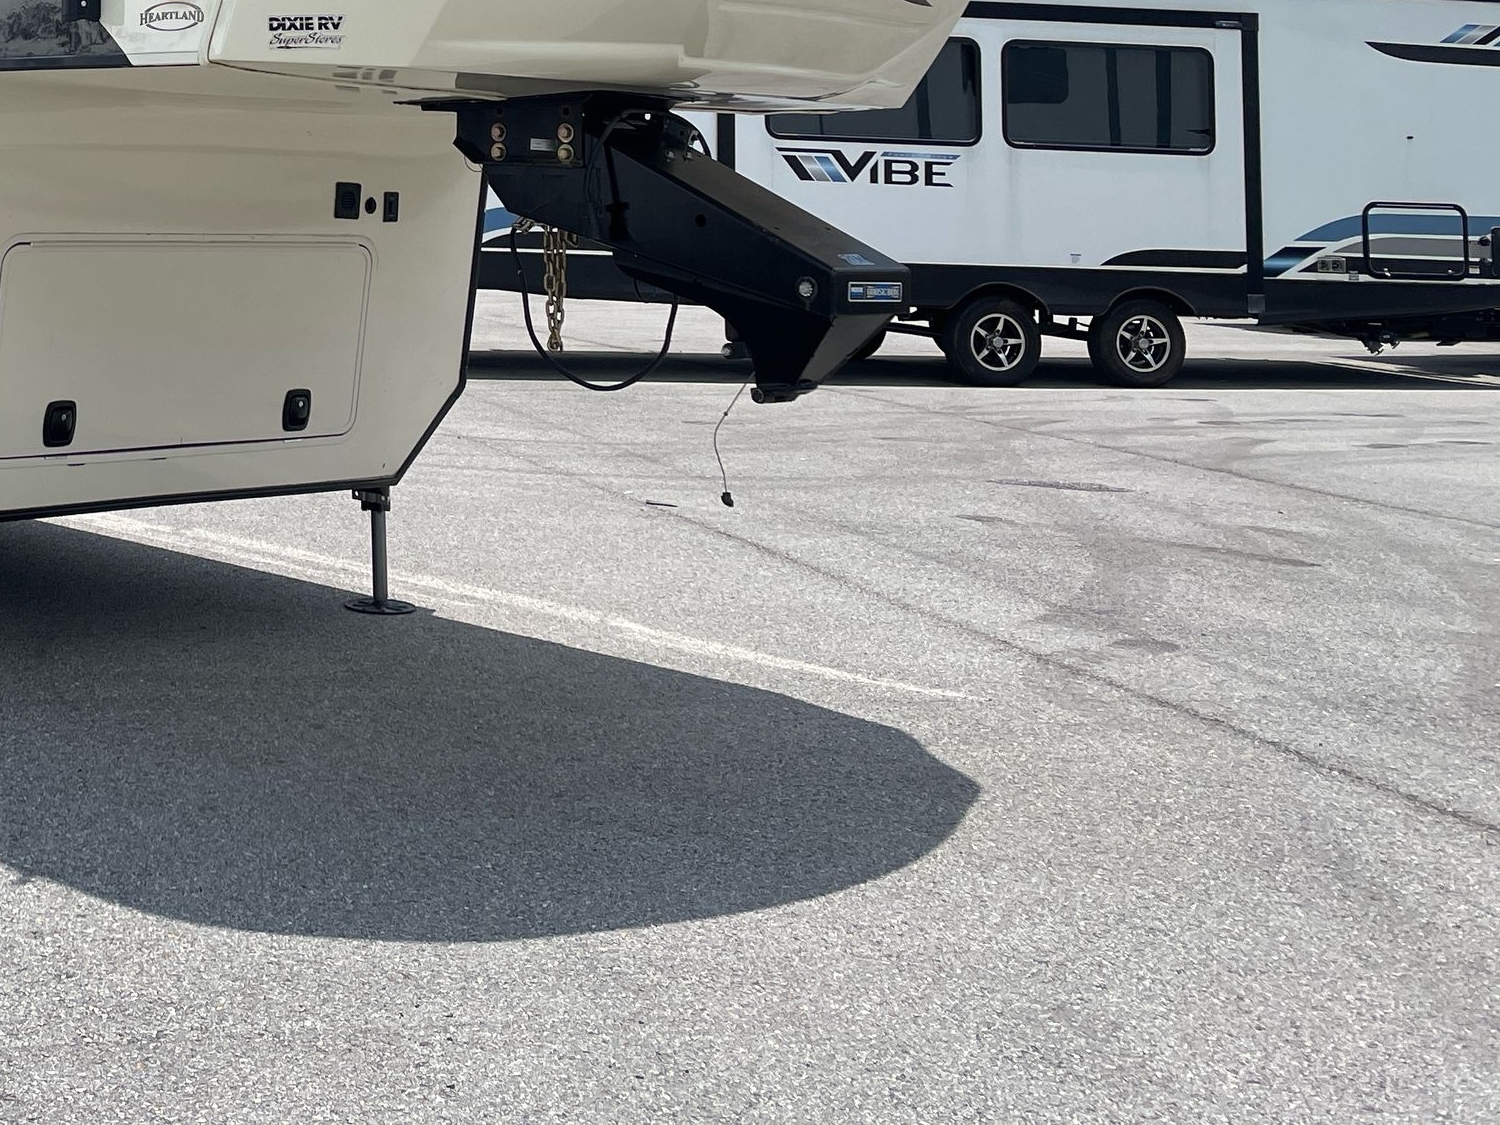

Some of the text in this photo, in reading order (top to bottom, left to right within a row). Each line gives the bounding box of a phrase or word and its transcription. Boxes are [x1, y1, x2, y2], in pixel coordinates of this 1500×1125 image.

[140, 10, 204, 26] HEARTLAND
[269, 16, 343, 31] DIXIE RV
[776, 147, 953, 187] VIBE
